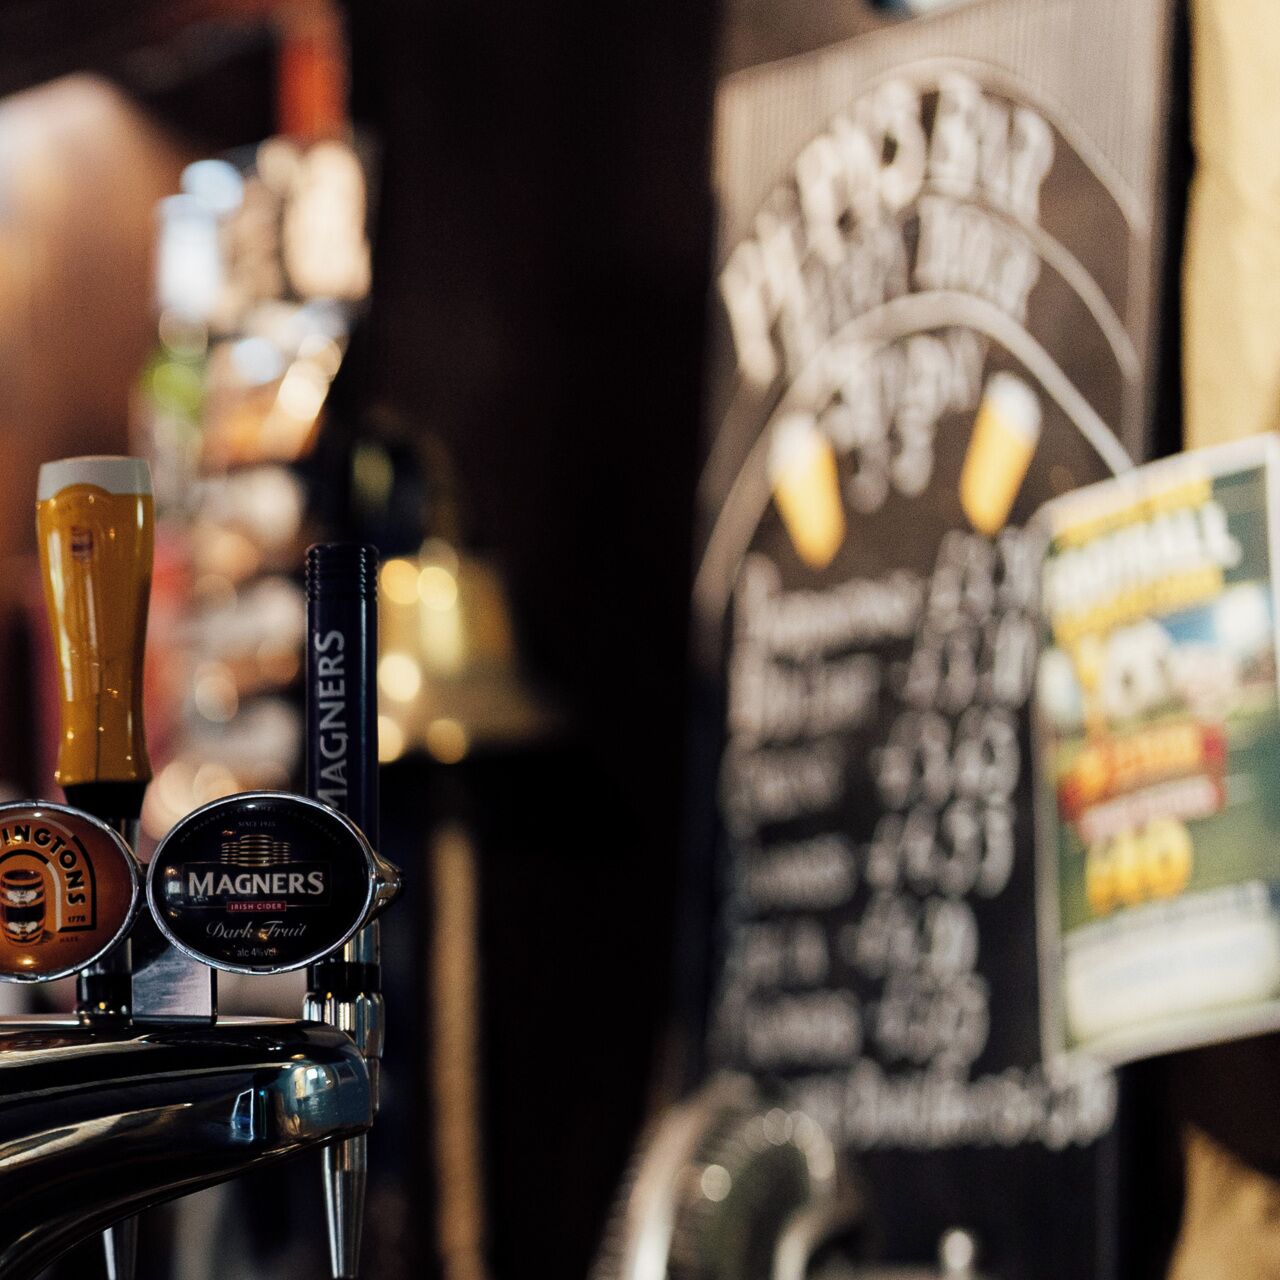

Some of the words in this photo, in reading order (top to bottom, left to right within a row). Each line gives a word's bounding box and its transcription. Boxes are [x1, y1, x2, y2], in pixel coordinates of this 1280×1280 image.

[188, 871, 325, 896] MAGNERS
[231, 903, 254, 911] IRISH
[256, 902, 282, 910] CIDER
[206, 920, 253, 939] Dark
[260, 920, 307, 937] Fruit
